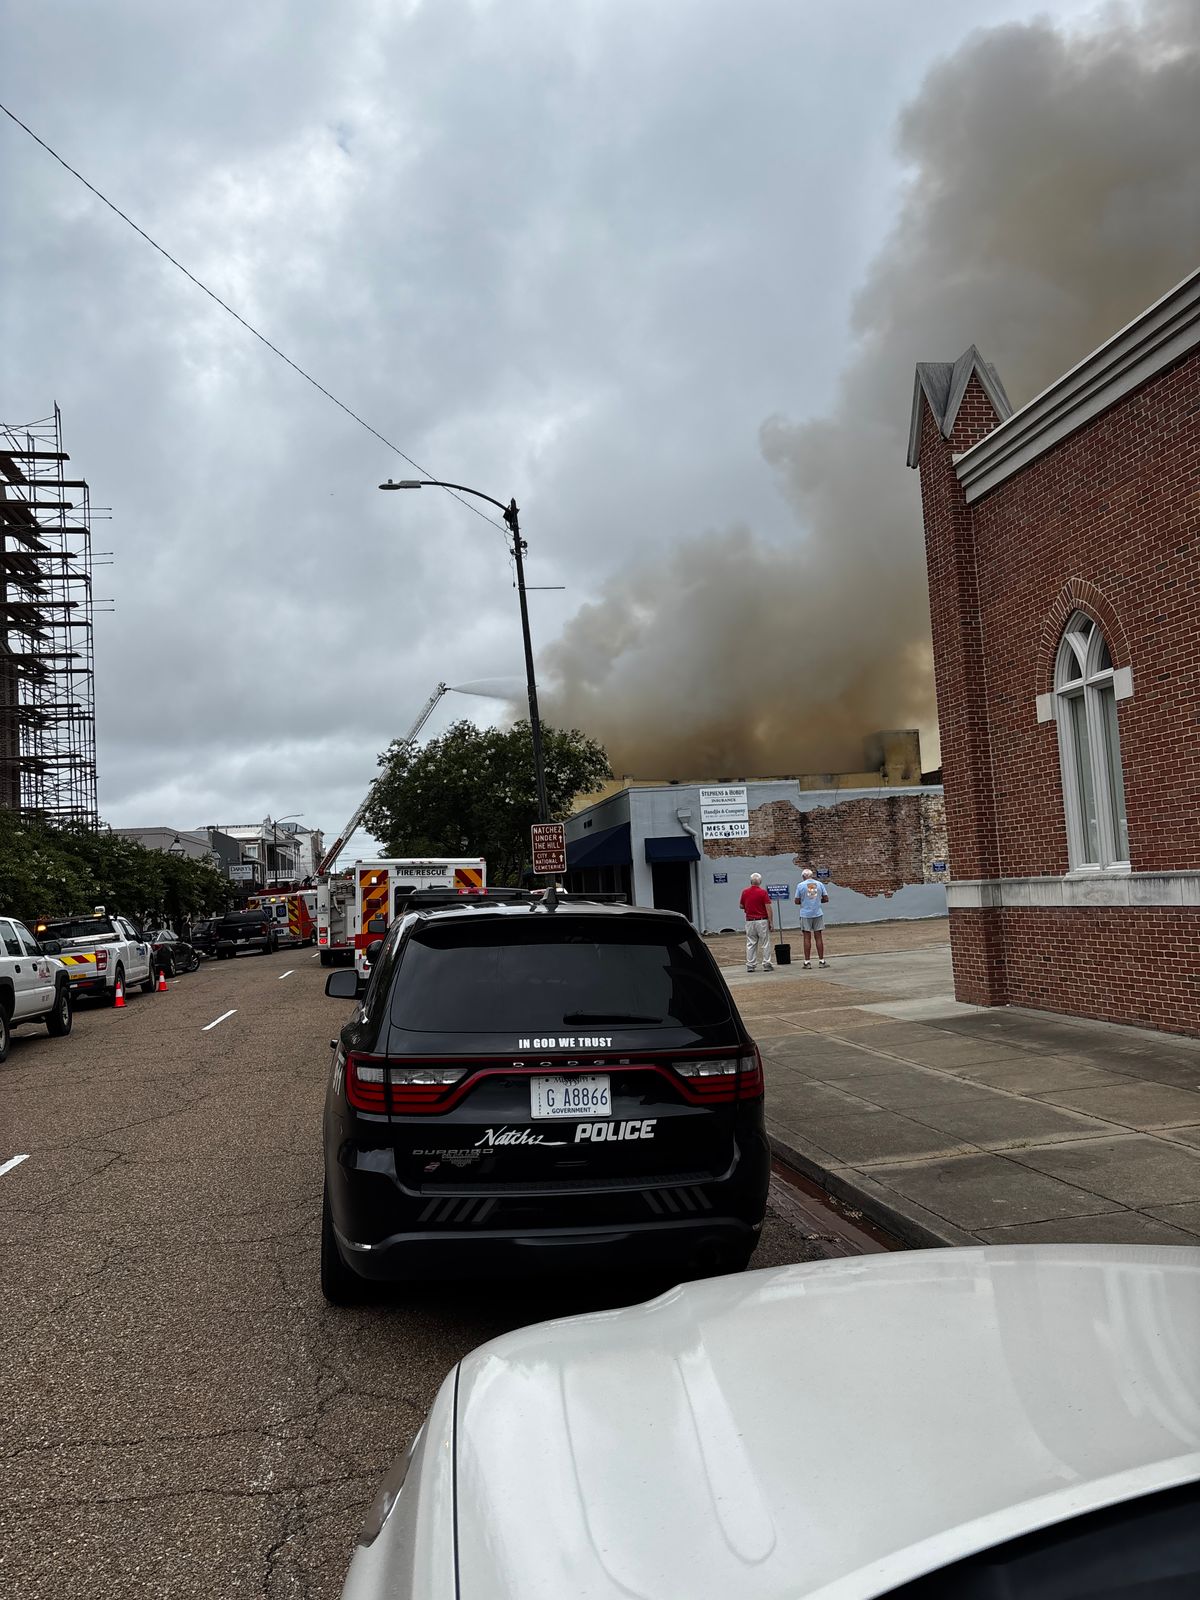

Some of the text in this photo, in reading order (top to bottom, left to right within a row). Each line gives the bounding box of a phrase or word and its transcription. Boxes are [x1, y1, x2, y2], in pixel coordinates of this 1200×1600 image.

[533, 826, 562, 834] NATCHEZ
[535, 834, 558, 842] UNDER
[518, 1037, 613, 1049] IN GOD WE TRUST
[546, 1088, 555, 1107] G
[563, 1087, 608, 1107] A8866
[551, 1106, 592, 1114] GOVERNMENT
[474, 1119, 657, 1147] Natchez POLICE
